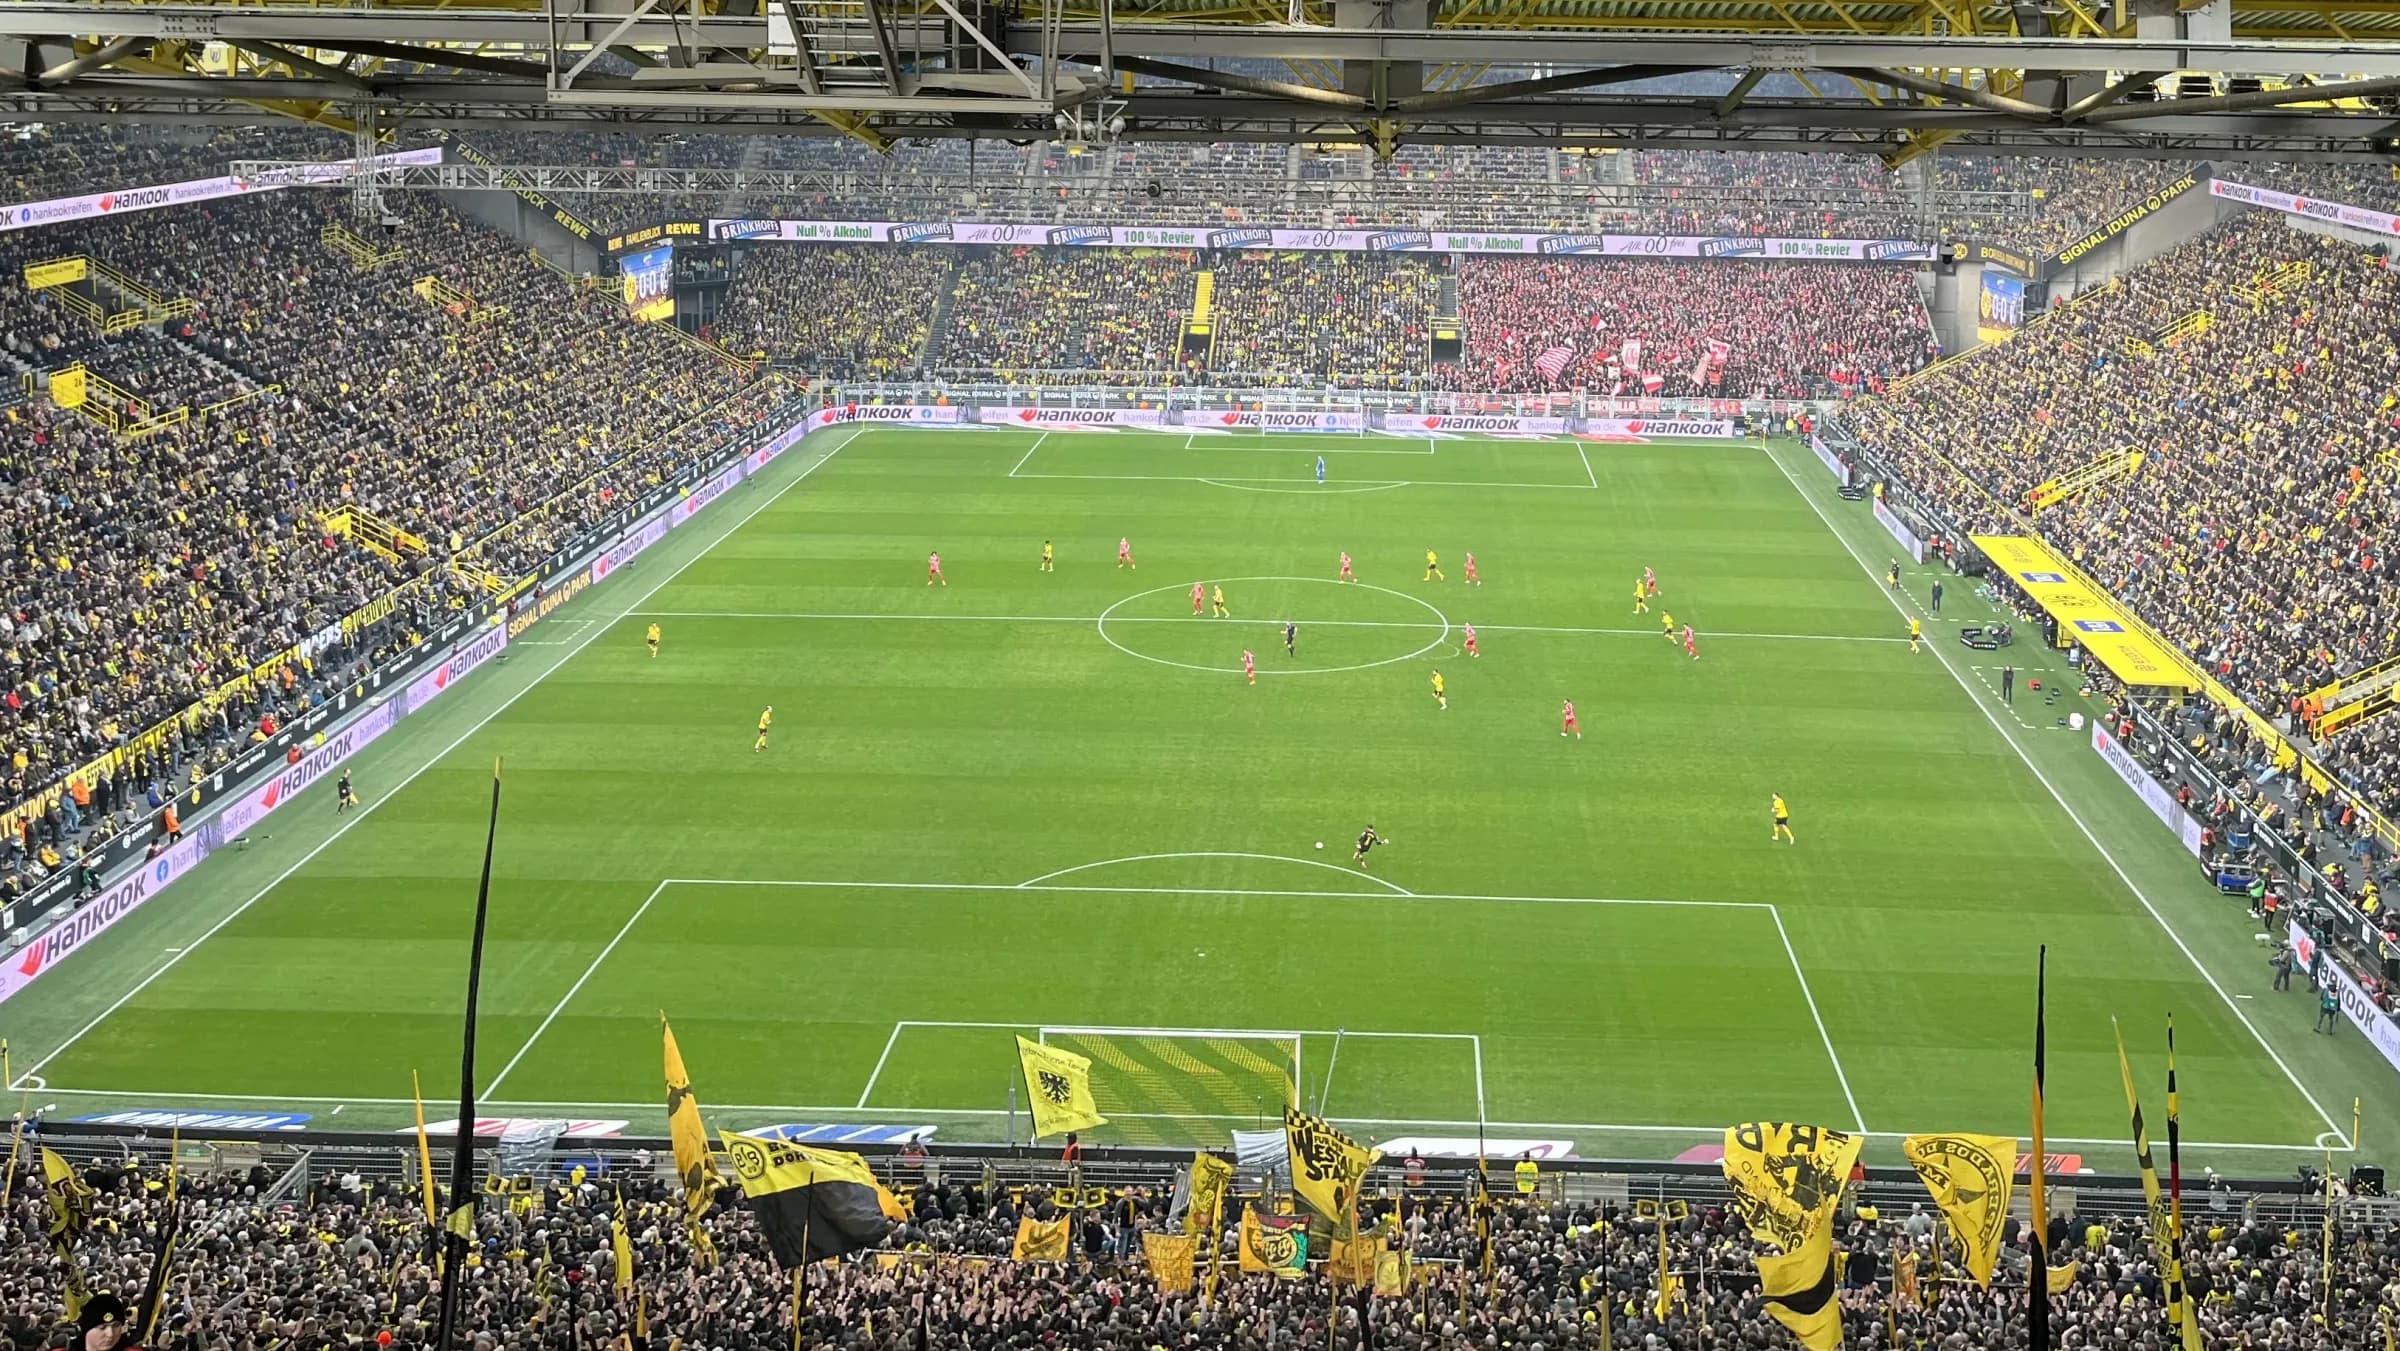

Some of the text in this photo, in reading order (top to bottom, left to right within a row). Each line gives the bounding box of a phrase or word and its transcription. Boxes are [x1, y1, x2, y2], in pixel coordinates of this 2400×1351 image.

[554, 210, 591, 240] REWE
[2058, 173, 2197, 265] SIGNAL IDUNA PARK
[665, 223, 701, 235] REWE
[796, 225, 817, 237] Null
[833, 225, 872, 238] Alkohol
[1124, 231, 1143, 243] 100
[1160, 231, 1195, 244] Revier
[1448, 236, 1468, 249] Null
[1485, 237, 1523, 250] Alkohol
[1778, 242, 1798, 255] 100
[1815, 243, 1850, 256] Revier
[508, 609, 539, 639] SIGNAL
[540, 590, 563, 620] IDUNA
[571, 570, 591, 596] PARK
